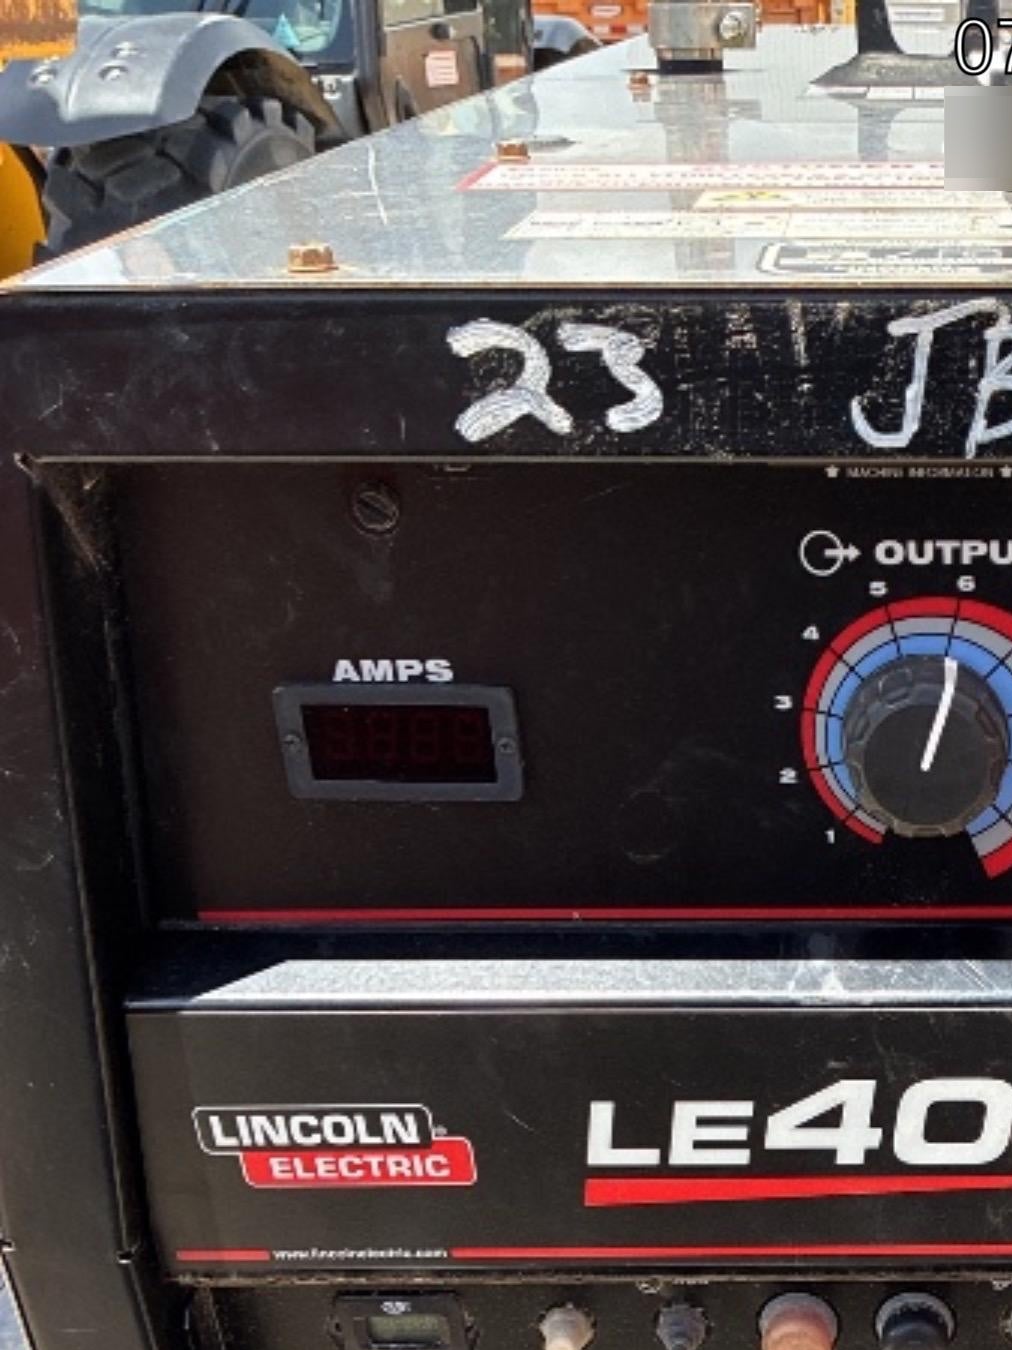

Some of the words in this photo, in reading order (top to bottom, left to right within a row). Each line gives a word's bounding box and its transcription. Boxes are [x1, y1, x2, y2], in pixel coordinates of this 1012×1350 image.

[446, 317, 664, 443] 23
[869, 582, 887, 596] 5
[957, 576, 976, 592] 6
[802, 626, 820, 641] 4
[333, 659, 454, 682] AMPS
[774, 696, 793, 710] 3
[779, 768, 798, 782] 2
[826, 829, 836, 844] 1
[208, 1112, 421, 1148] LINCOLN
[269, 1155, 451, 1180] ELECTRIC
